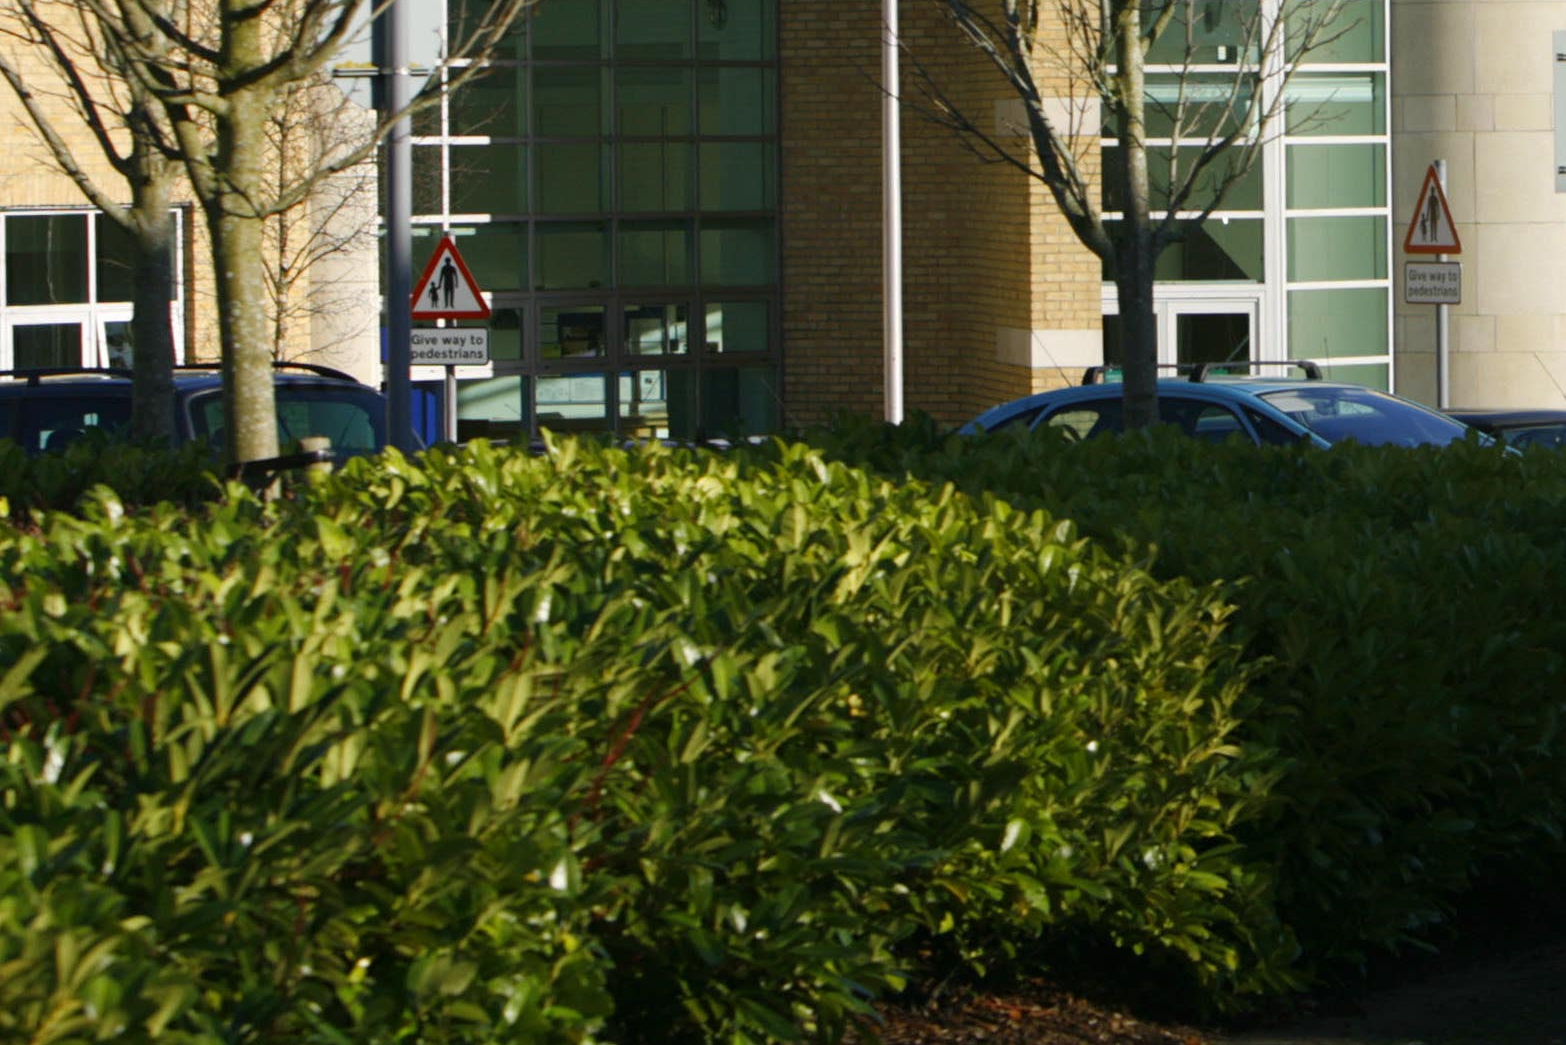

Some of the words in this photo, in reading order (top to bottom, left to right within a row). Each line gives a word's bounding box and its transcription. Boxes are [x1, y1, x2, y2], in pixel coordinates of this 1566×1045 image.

[1409, 269, 1427, 281] Give
[1430, 272, 1446, 284] way
[1448, 270, 1457, 282] to
[1408, 286, 1458, 298] pedestrians
[411, 334, 438, 345] Give
[442, 337, 466, 347] way
[470, 335, 483, 345] to
[410, 348, 483, 360] pedestrians
